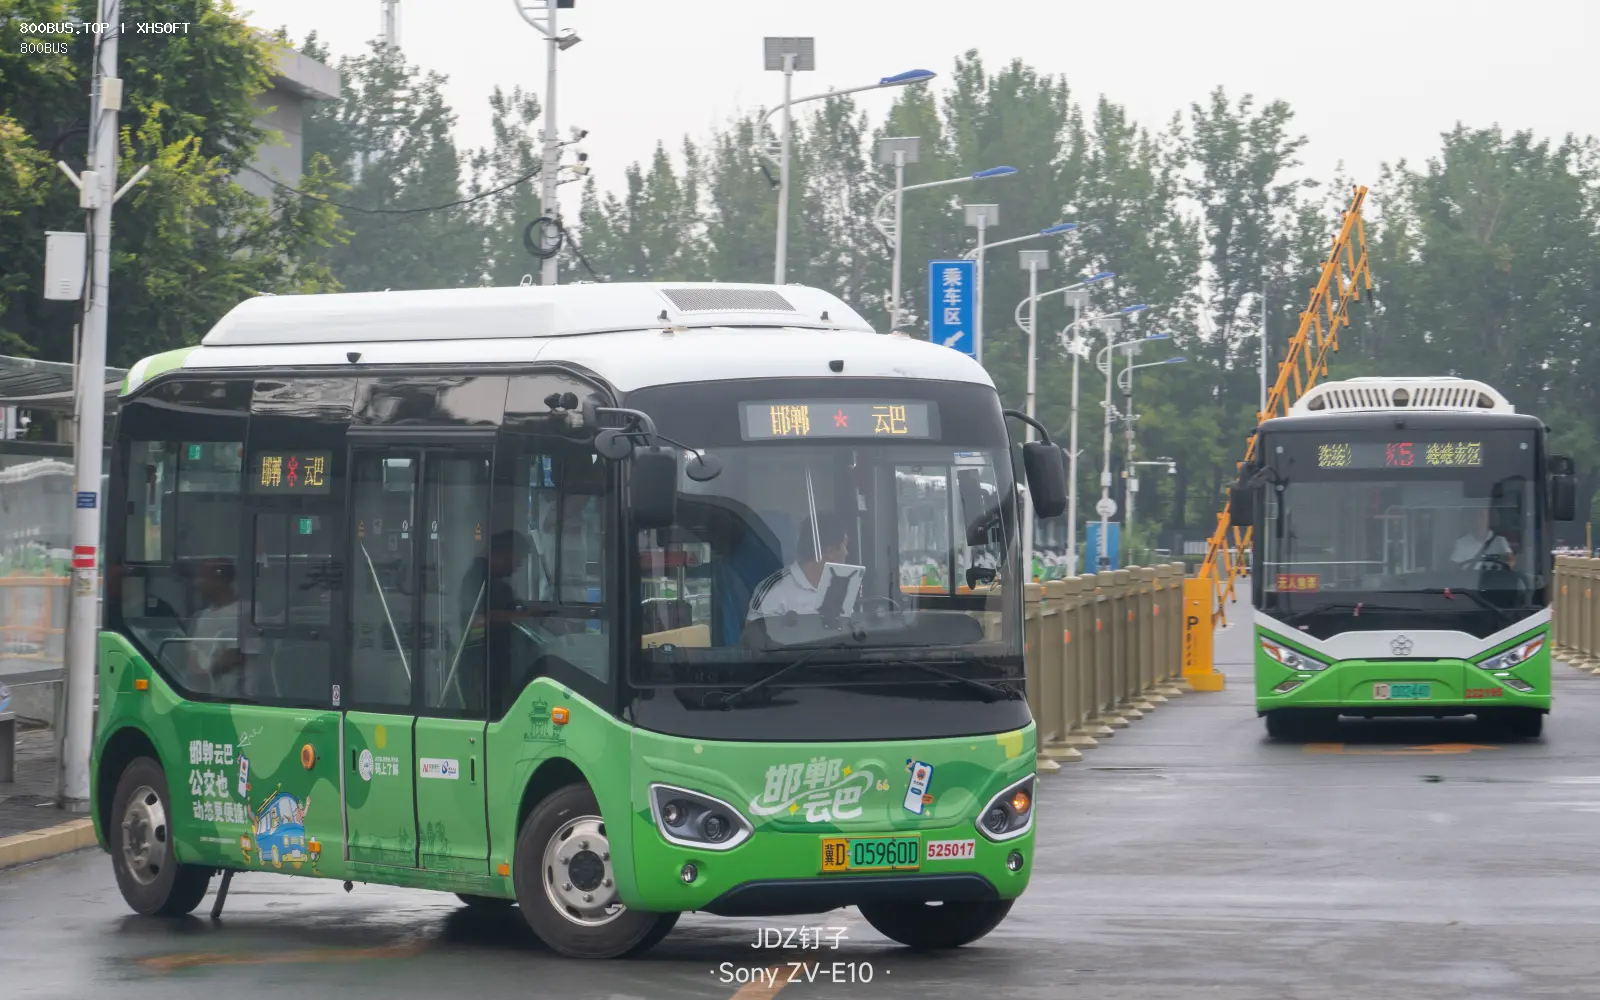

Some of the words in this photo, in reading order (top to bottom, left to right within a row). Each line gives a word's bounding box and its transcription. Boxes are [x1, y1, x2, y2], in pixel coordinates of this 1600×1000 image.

[942, 267, 963, 325] 乘车区
[770, 404, 810, 436] 邯郸
[871, 405, 908, 434] 云巴
[189, 739, 234, 766] 邯郸云巴
[188, 768, 230, 798] 公交也
[763, 757, 844, 804] 邯郸
[803, 786, 863, 823] 云巴
[855, 841, 919, 866] 05960D
[927, 842, 975, 858] 525017
